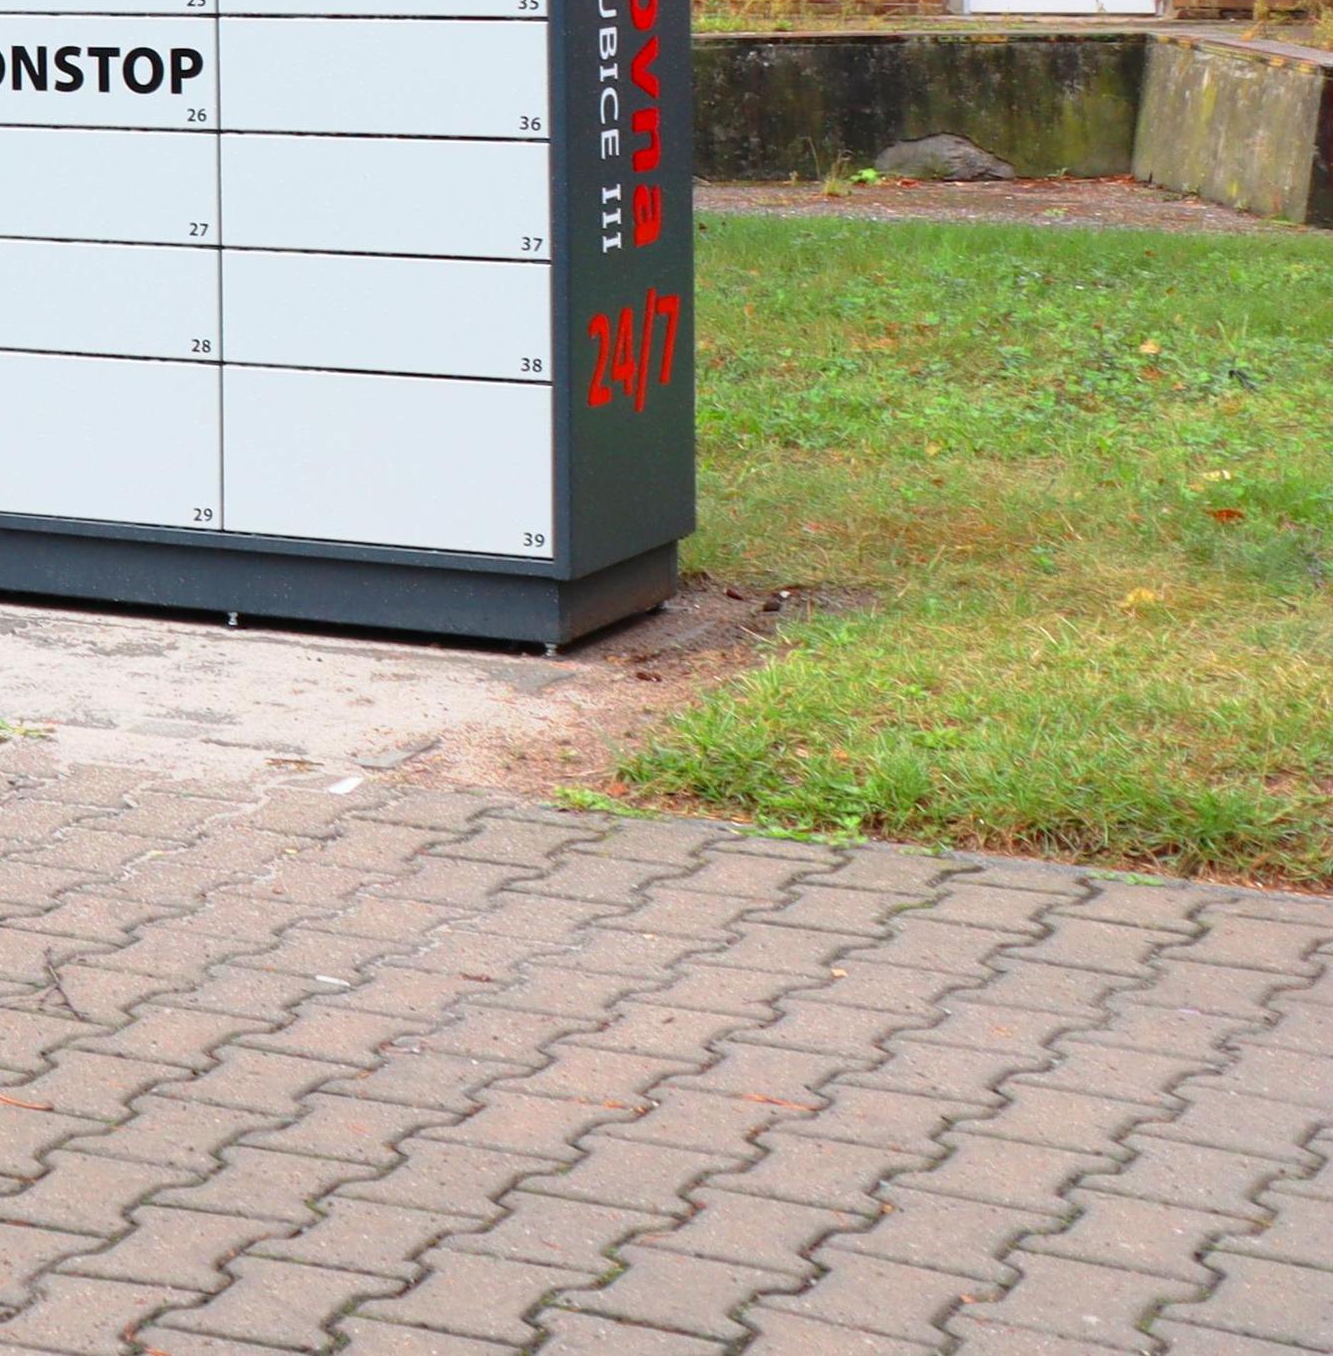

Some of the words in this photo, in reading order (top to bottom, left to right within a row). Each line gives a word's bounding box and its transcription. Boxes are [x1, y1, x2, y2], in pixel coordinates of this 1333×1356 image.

[187, 109, 207, 122] 26
[519, 116, 541, 131] 36
[601, 183, 622, 253] III
[189, 223, 209, 236] 27
[520, 237, 542, 251] 37
[191, 339, 211, 353] 28
[587, 287, 681, 412] 24/7
[521, 358, 543, 372] 38
[193, 508, 213, 521] 29
[523, 533, 544, 547] 39
